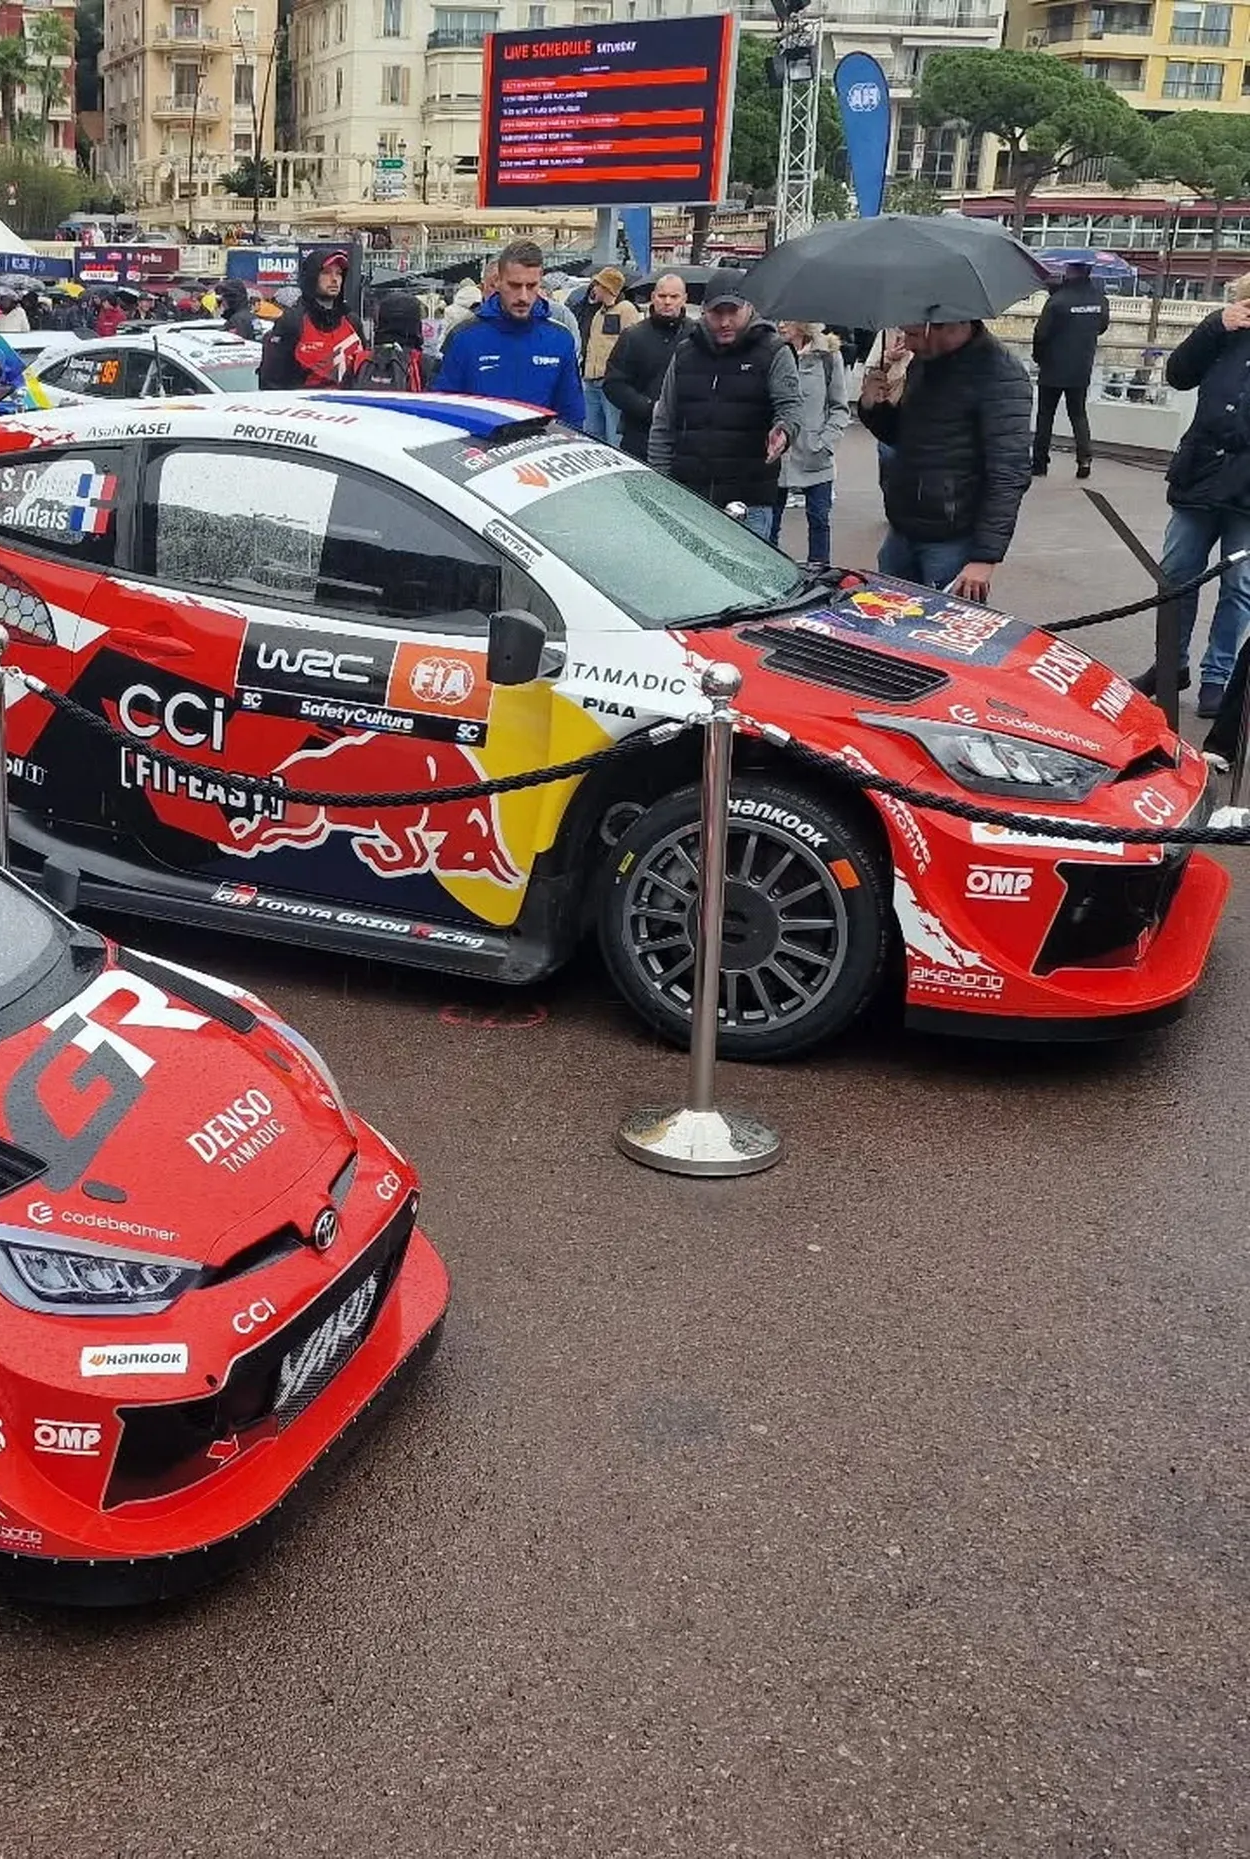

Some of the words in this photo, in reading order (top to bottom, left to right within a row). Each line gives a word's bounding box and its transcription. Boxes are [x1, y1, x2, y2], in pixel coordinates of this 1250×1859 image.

[504, 45, 528, 59] LIVE
[532, 40, 591, 57] SCHEDULE
[233, 424, 318, 449] PROTERIAL
[483, 520, 540, 567] CENTRAL
[256, 643, 374, 683] WRC
[572, 663, 688, 695] TAMADIC
[414, 659, 472, 700] FIA
[242, 692, 262, 708] SC
[299, 700, 414, 731] SafetyCulture
[582, 697, 637, 720] PIAA
[457, 723, 480, 741] SC
[967, 871, 1032, 896] OMP
[212, 886, 256, 907] GR
[255, 897, 333, 921] TOYOTA
[336, 912, 411, 934] GAZOO
[409, 923, 485, 949] Racing
[3, 969, 211, 1193] GR
[185, 1088, 273, 1164] DENSO
[220, 1119, 287, 1174] TAMADIC
[62, 1210, 180, 1242] codebeamer
[34, 1425, 102, 1451] OMP
